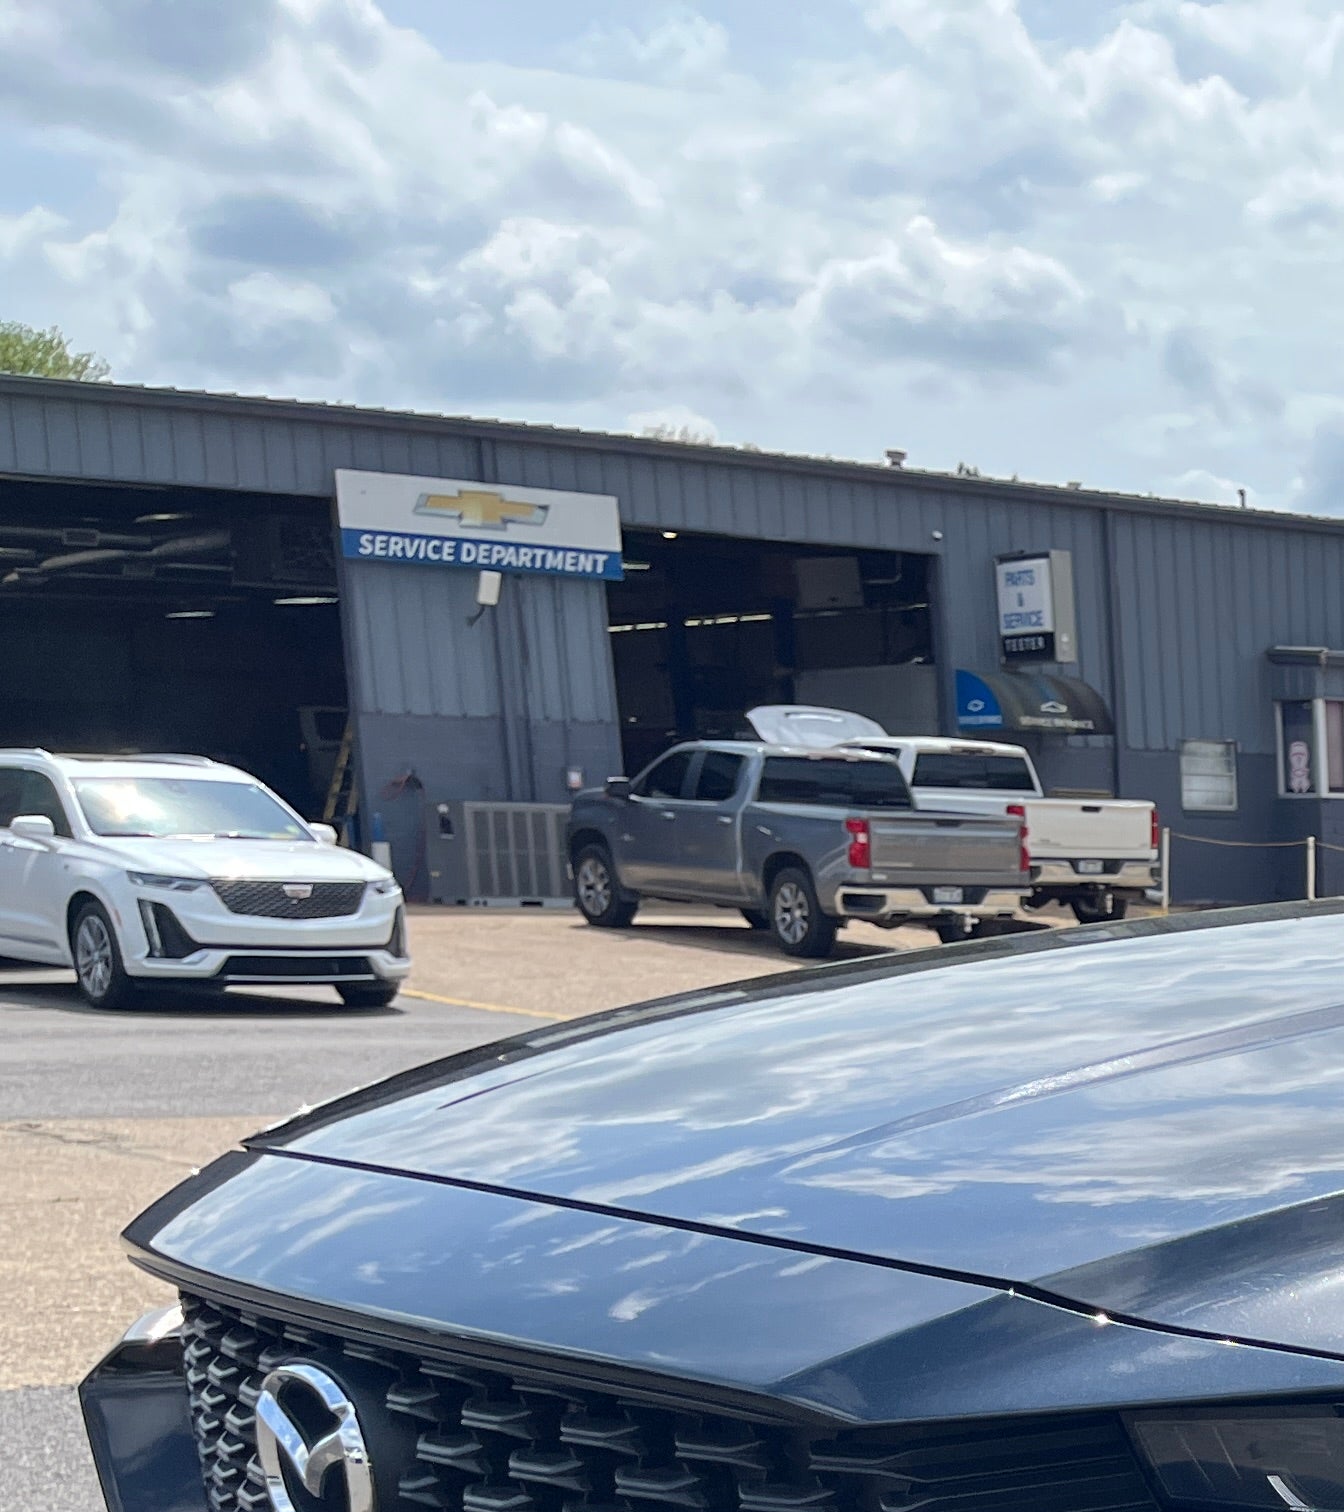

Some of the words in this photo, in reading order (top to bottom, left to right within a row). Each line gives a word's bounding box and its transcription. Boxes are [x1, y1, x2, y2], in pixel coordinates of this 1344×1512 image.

[358, 533, 455, 562] SERVICE
[460, 542, 609, 575] DEPARTMENT
[1005, 569, 1035, 587] PARTS
[1003, 611, 1043, 629] SERVICE
